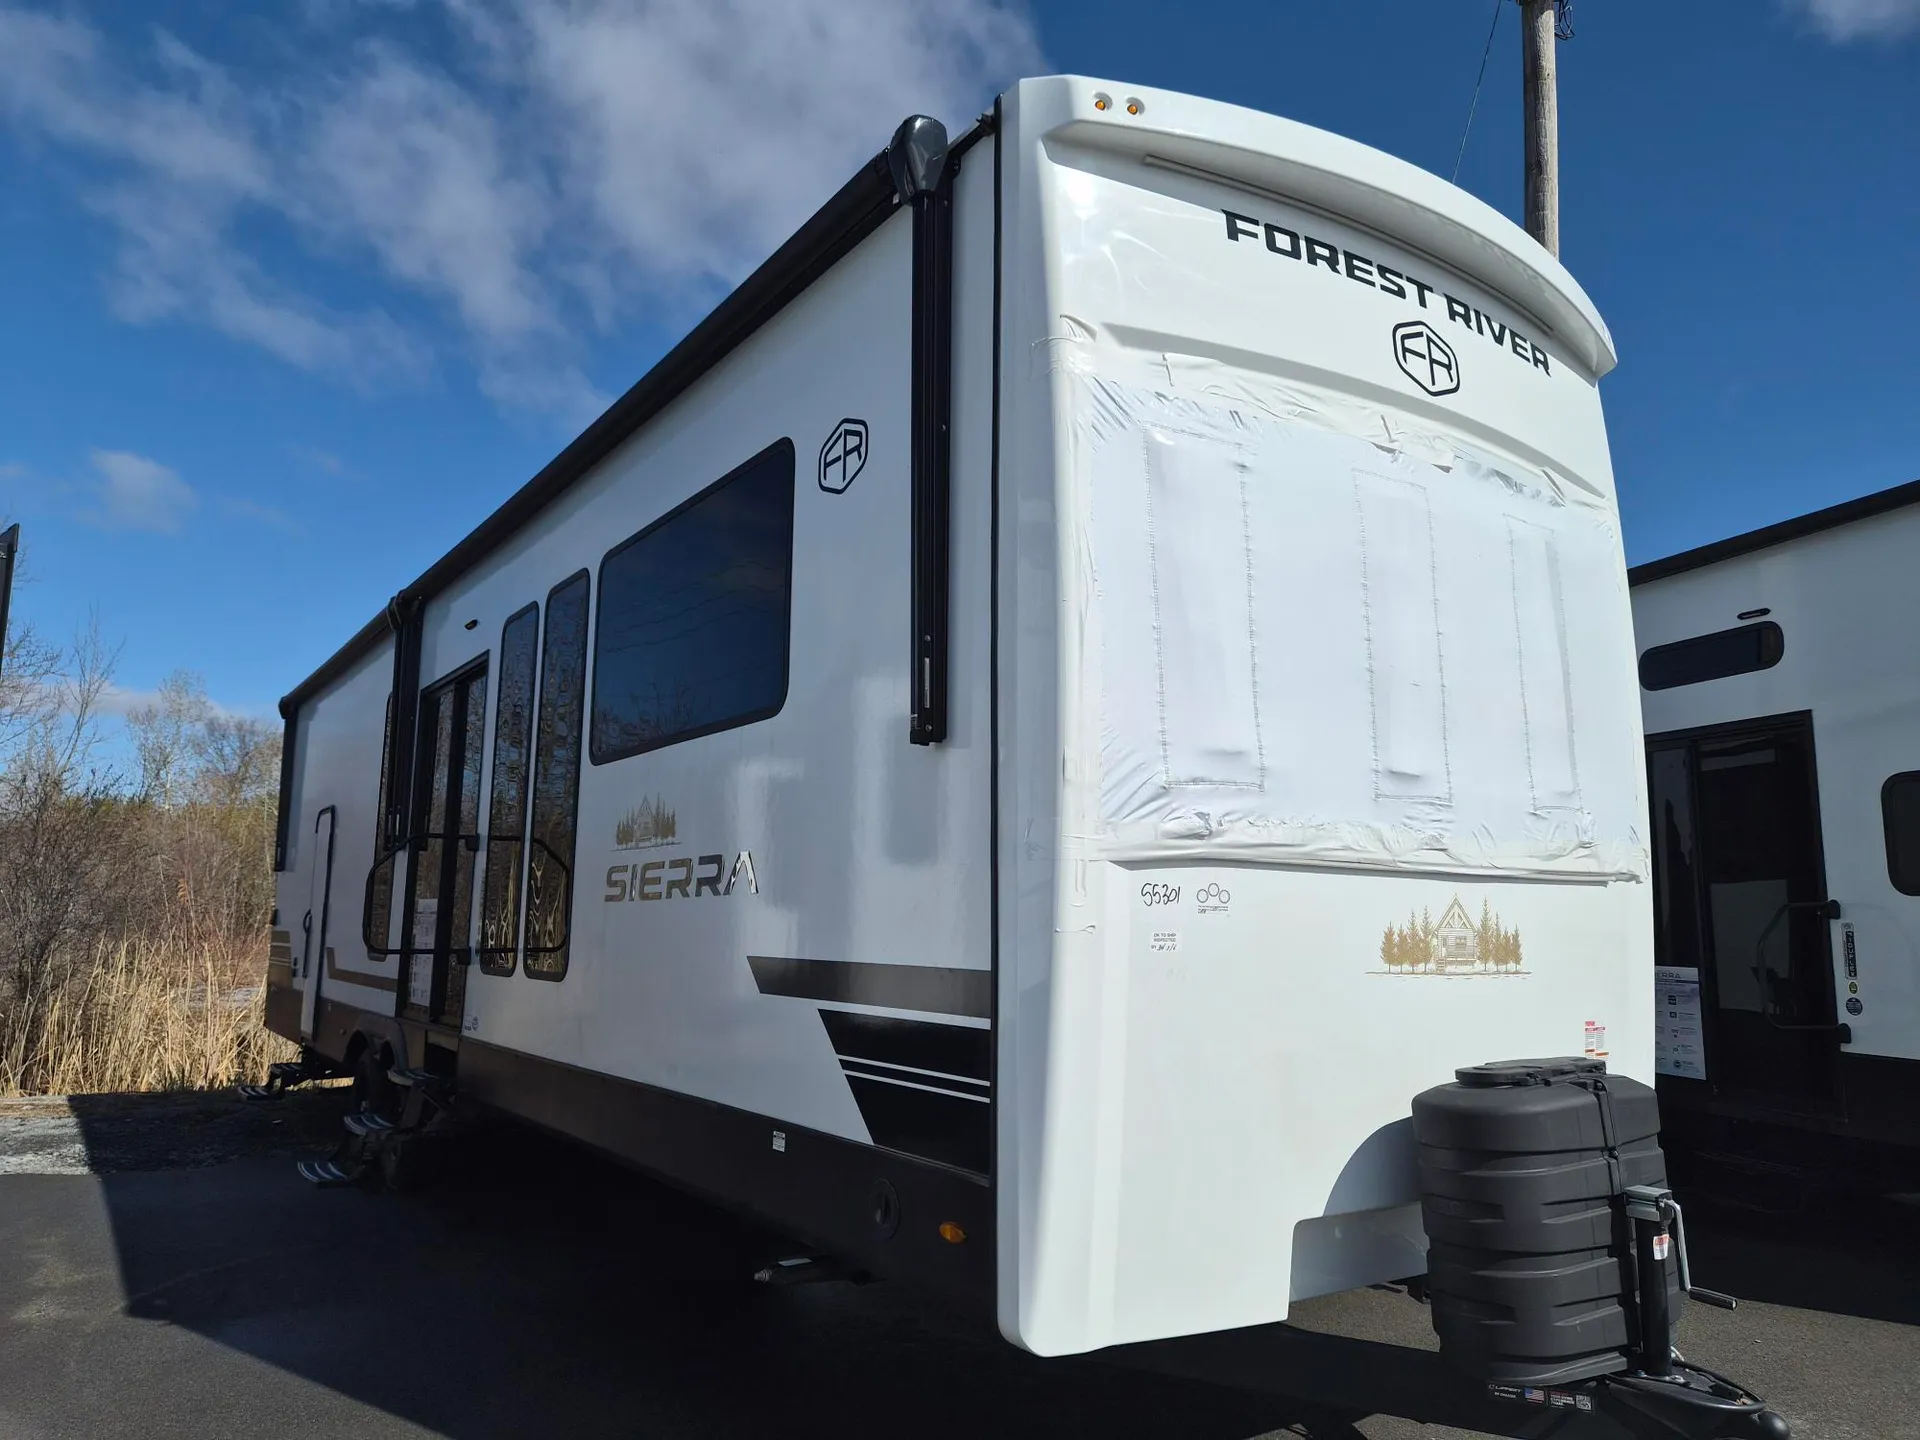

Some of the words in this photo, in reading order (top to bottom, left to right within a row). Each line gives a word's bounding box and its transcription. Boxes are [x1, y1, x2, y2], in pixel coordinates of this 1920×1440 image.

[1220, 209, 1433, 309] FOREST
[1443, 293, 1552, 378] RIVER
[604, 850, 759, 902] SIERRA
[1141, 882, 1181, 907] 55301
